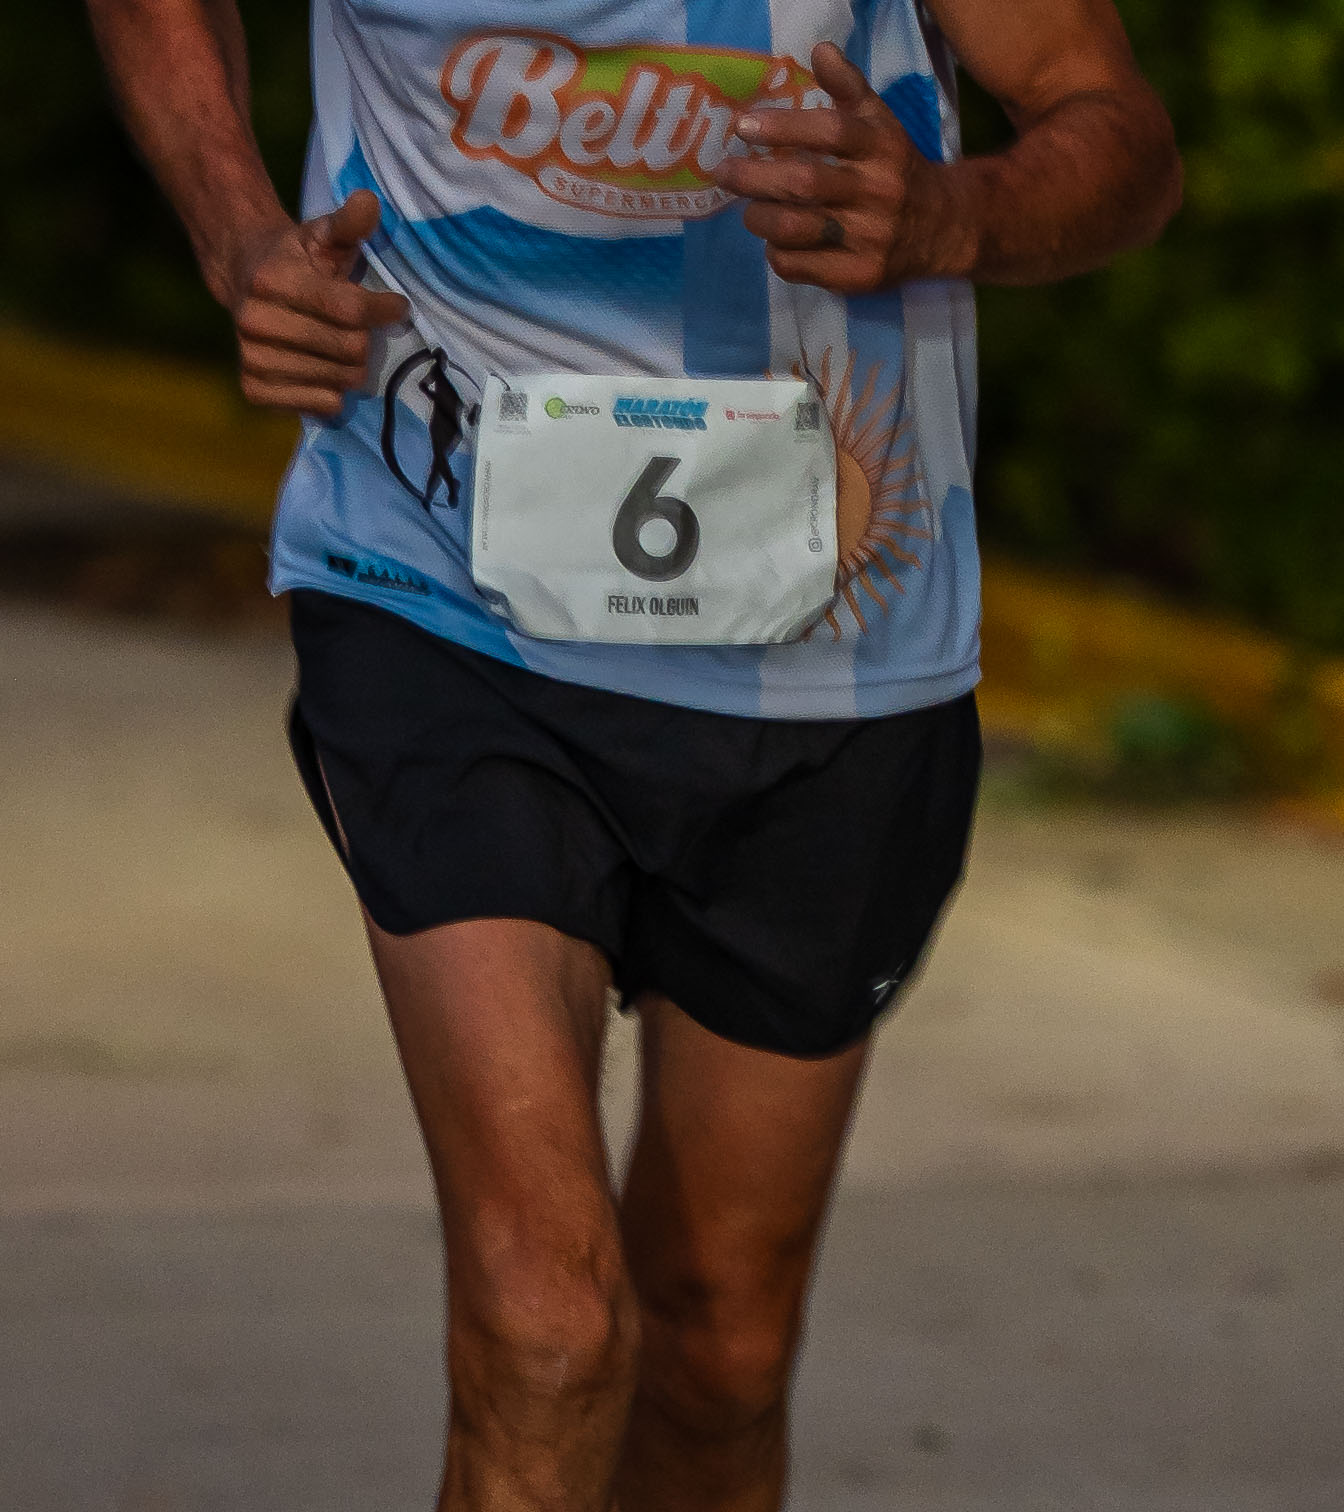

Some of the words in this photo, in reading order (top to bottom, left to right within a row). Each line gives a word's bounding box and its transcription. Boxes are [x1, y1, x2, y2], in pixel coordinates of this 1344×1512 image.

[554, 176, 729, 211] SUPERMERCA
[612, 456, 700, 583] 6
[608, 594, 646, 615] FELIX
[649, 597, 699, 616] OLGUIN
